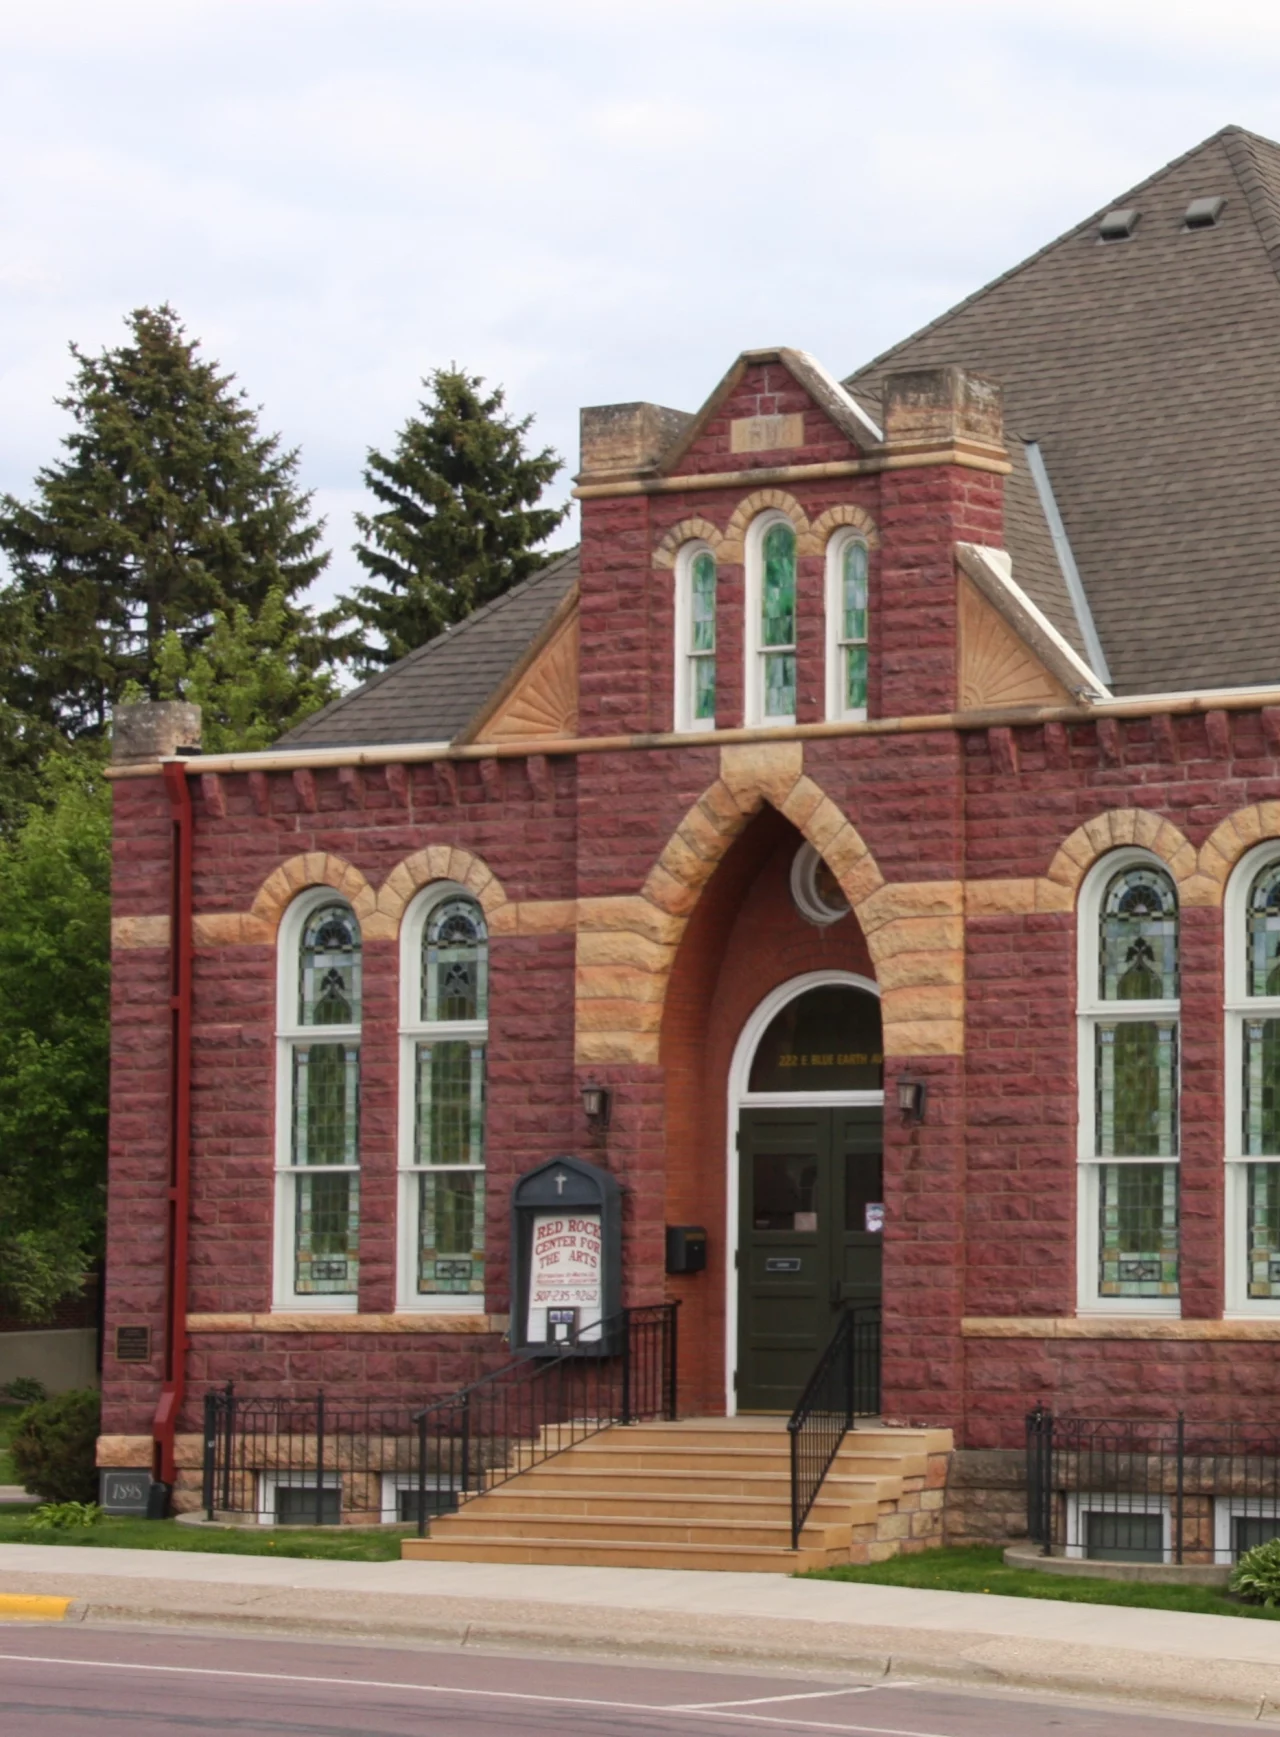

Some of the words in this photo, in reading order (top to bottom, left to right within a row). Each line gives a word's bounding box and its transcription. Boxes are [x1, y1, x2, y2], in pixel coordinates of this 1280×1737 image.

[537, 1220, 563, 1240] RED
[536, 1235, 577, 1255] CENTER
[580, 1236, 600, 1255] FOR
[539, 1251, 561, 1269] THE
[568, 1250, 597, 1268] ARTS
